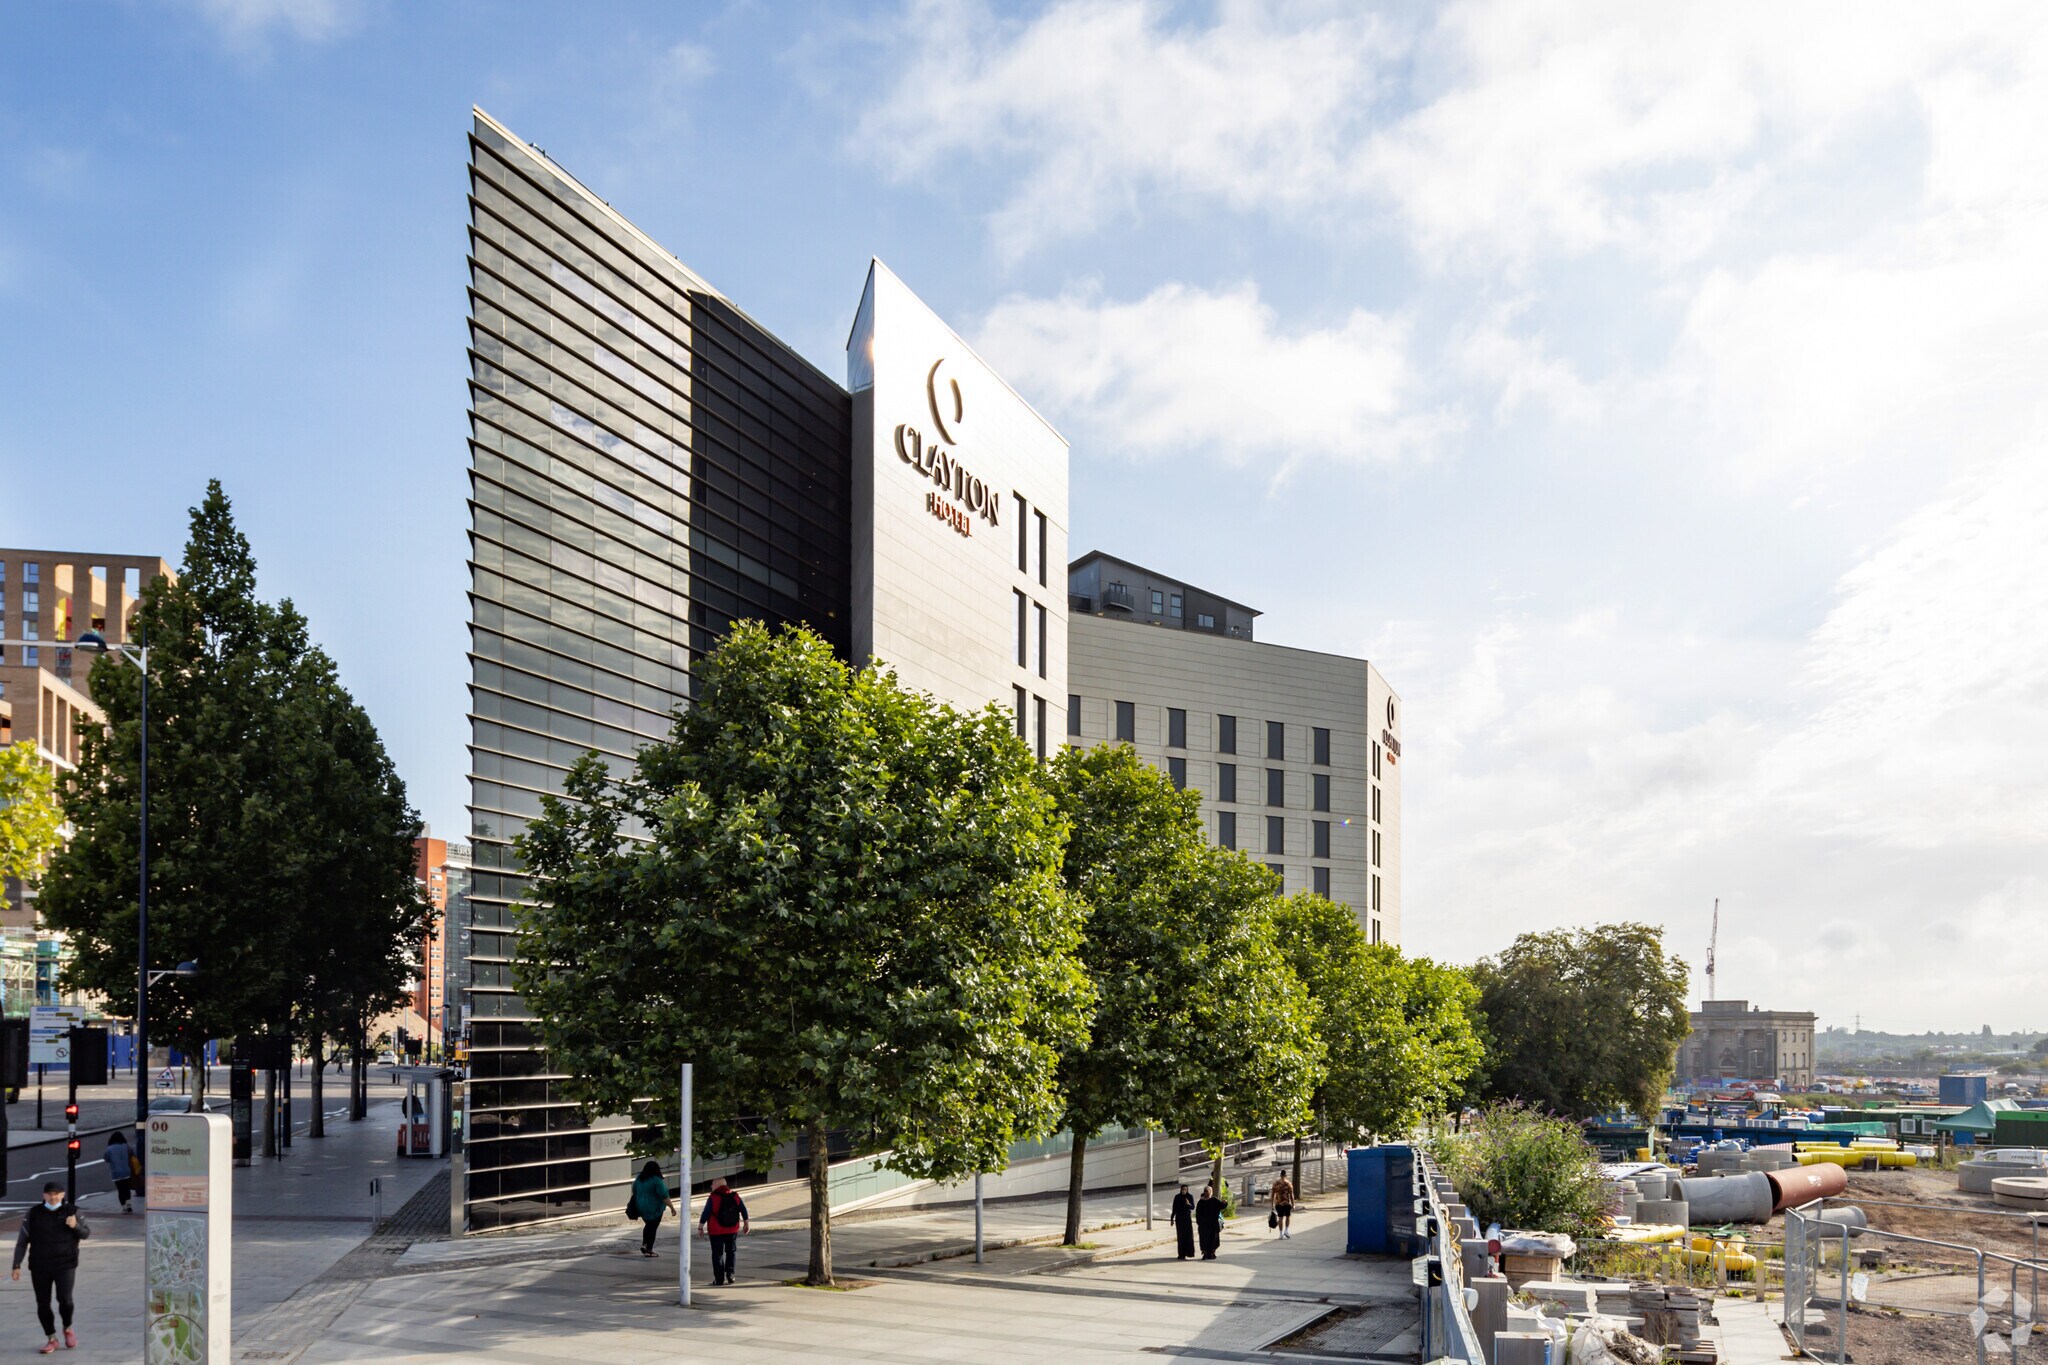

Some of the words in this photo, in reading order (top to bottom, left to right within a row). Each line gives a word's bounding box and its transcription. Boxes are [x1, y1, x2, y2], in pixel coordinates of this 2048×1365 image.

[894, 424, 999, 526] CLAYTON
[926, 492, 972, 537] HOTEL
[151, 1146, 170, 1155] Albert
[172, 1147, 191, 1155] Street
